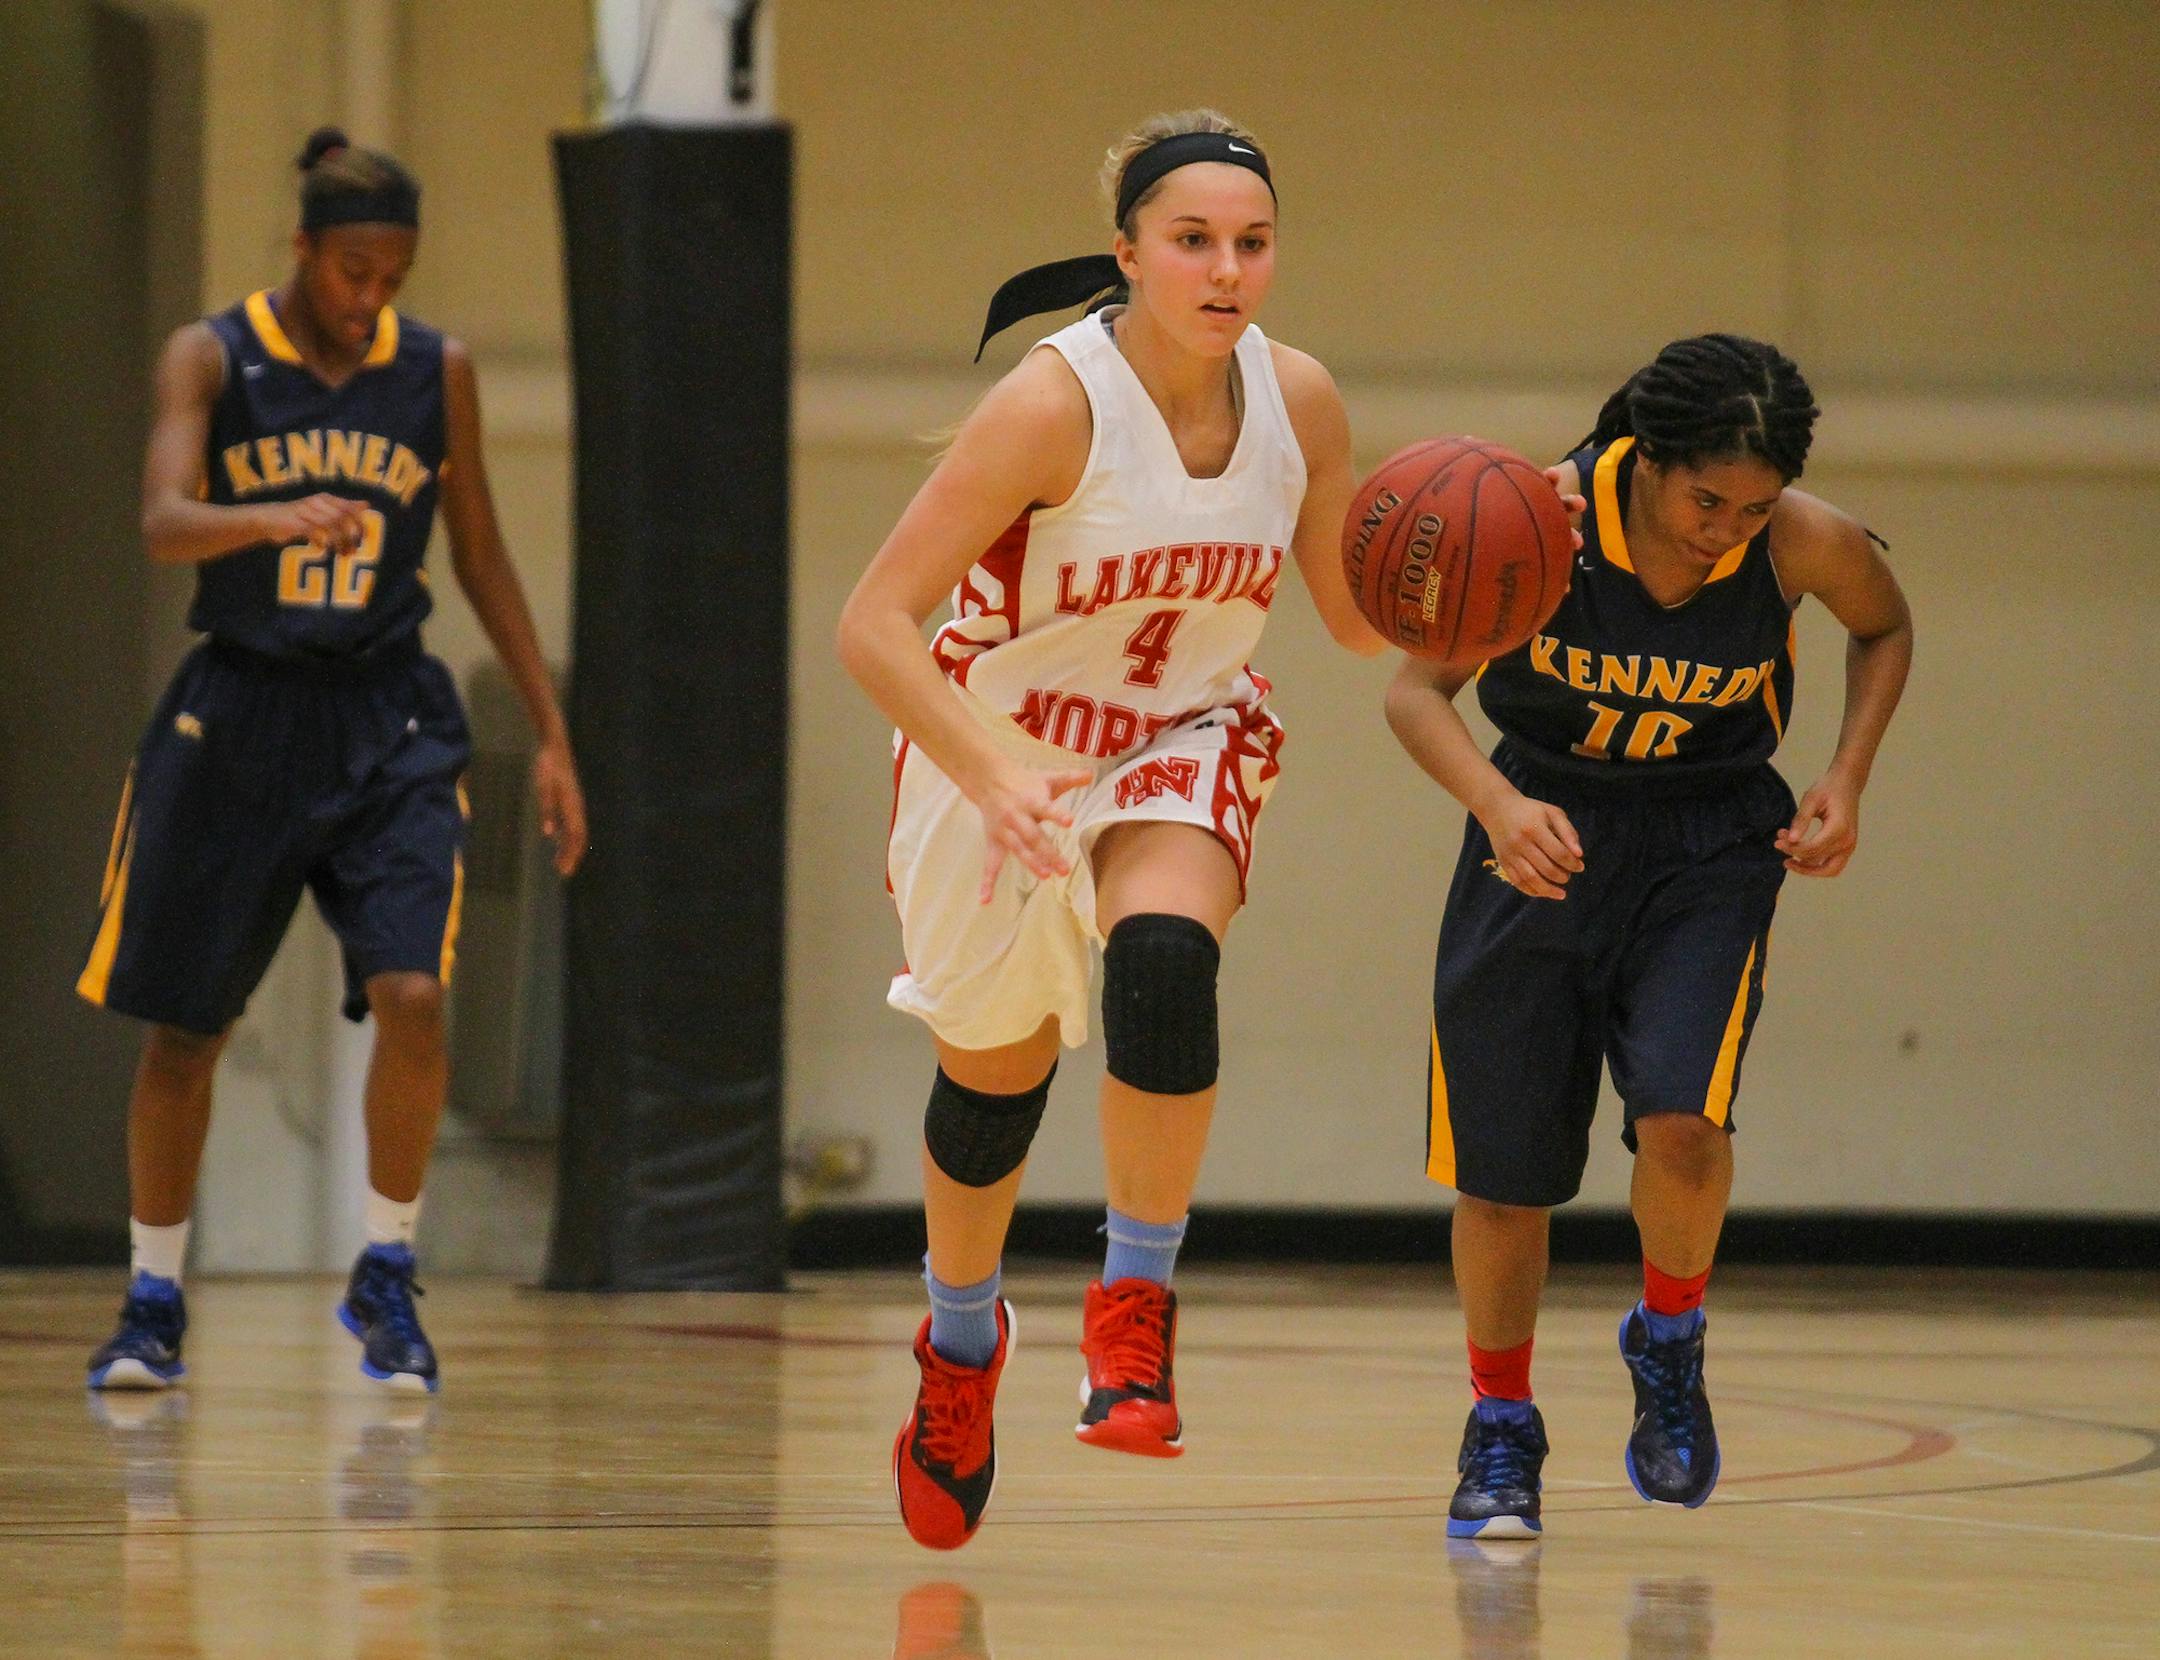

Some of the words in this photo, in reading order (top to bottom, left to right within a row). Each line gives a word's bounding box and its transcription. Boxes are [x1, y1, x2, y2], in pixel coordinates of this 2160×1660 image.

[278, 509, 385, 608] 22
[1055, 541, 1284, 617] LAKEVILL
[1423, 567, 1441, 622] LEGACY
[1123, 609, 1187, 688] 4
